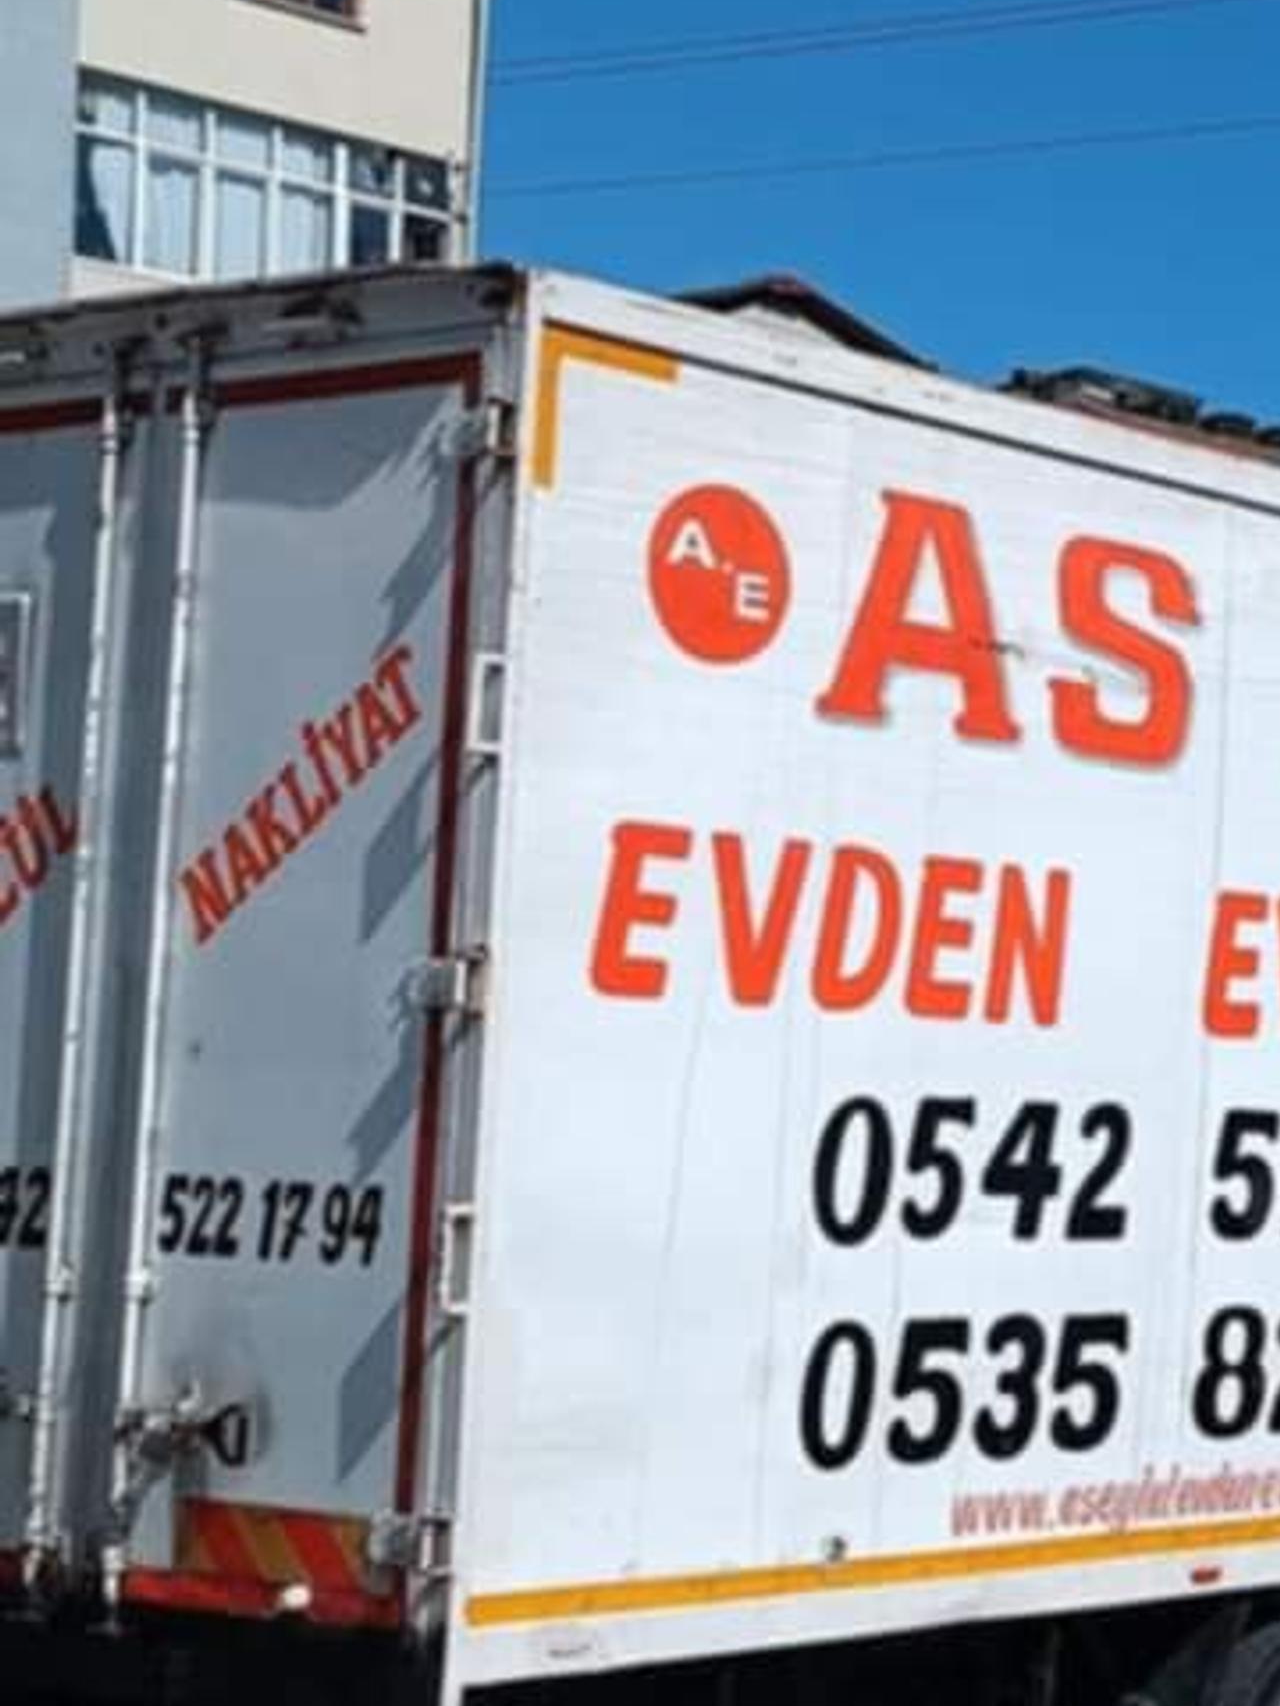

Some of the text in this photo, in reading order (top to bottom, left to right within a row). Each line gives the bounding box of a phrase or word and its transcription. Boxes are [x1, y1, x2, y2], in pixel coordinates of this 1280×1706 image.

[816, 488, 1199, 771] AS
[182, 644, 421, 946] NAKLİYAT
[587, 819, 1072, 1027] EVDEN
[157, 1170, 245, 1258] 522
[256, 1178, 314, 1263] 17
[319, 1181, 385, 1268] 94
[812, 1095, 1132, 1247] 0542
[799, 1311, 1131, 1472] 0535
